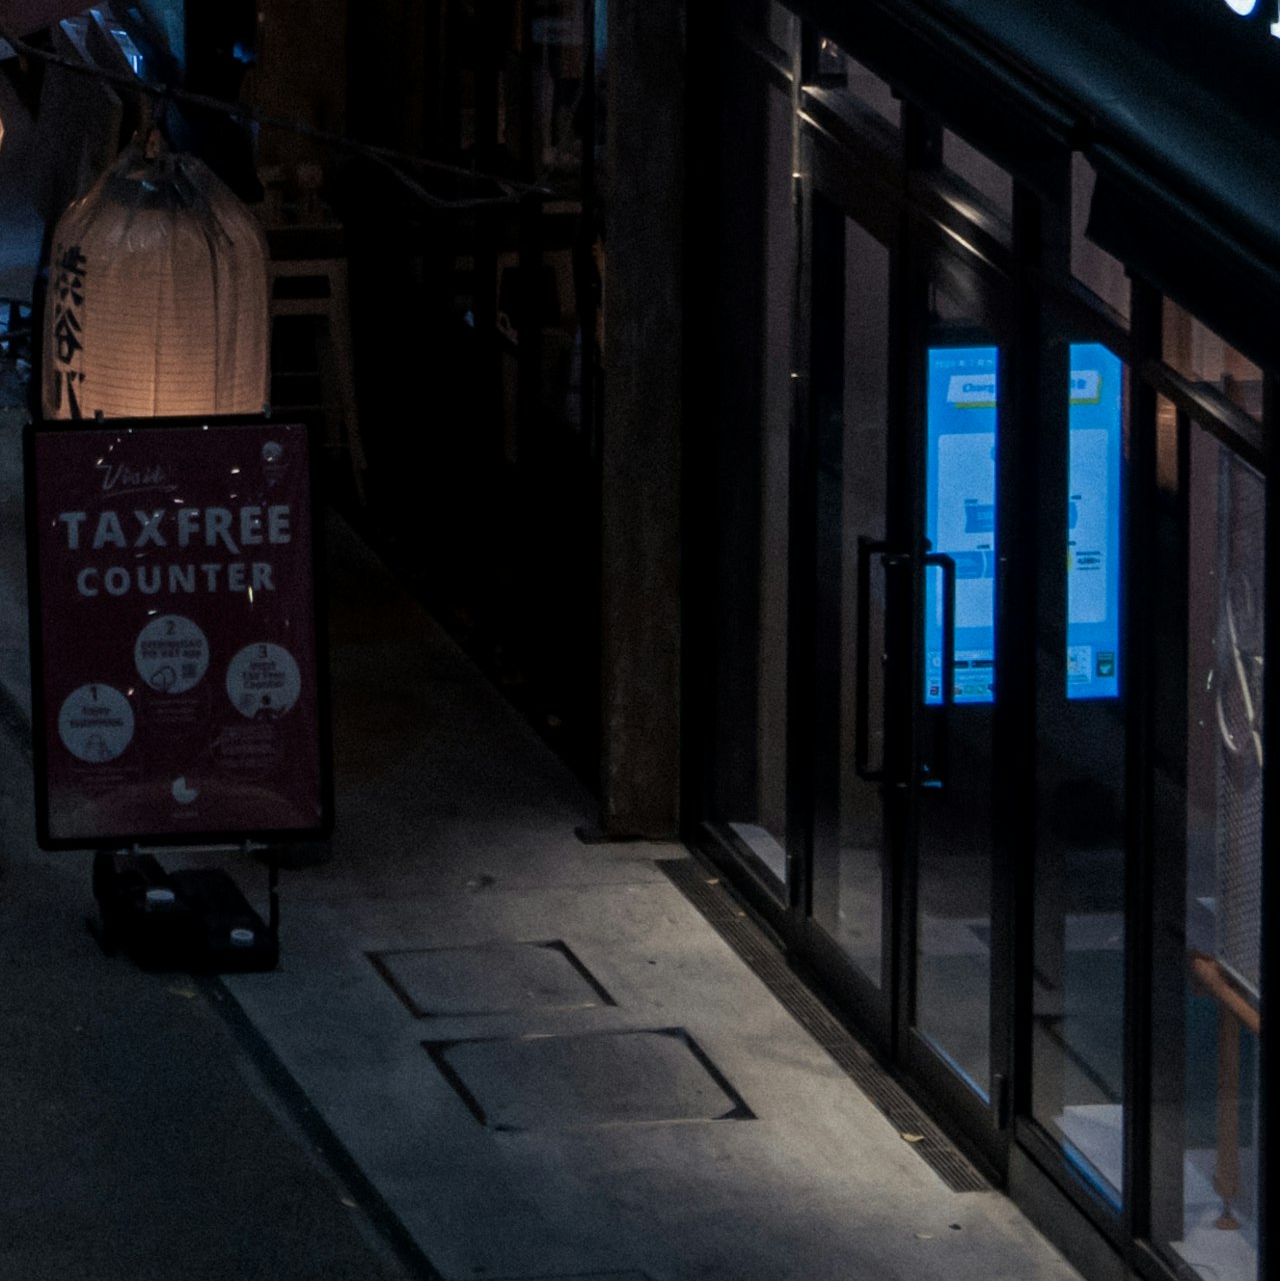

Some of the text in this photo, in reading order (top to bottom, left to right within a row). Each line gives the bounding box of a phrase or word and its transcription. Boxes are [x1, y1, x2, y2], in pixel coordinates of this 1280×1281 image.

[58, 504, 292, 555] TAX FREE
[76, 561, 276, 597] COUNTER
